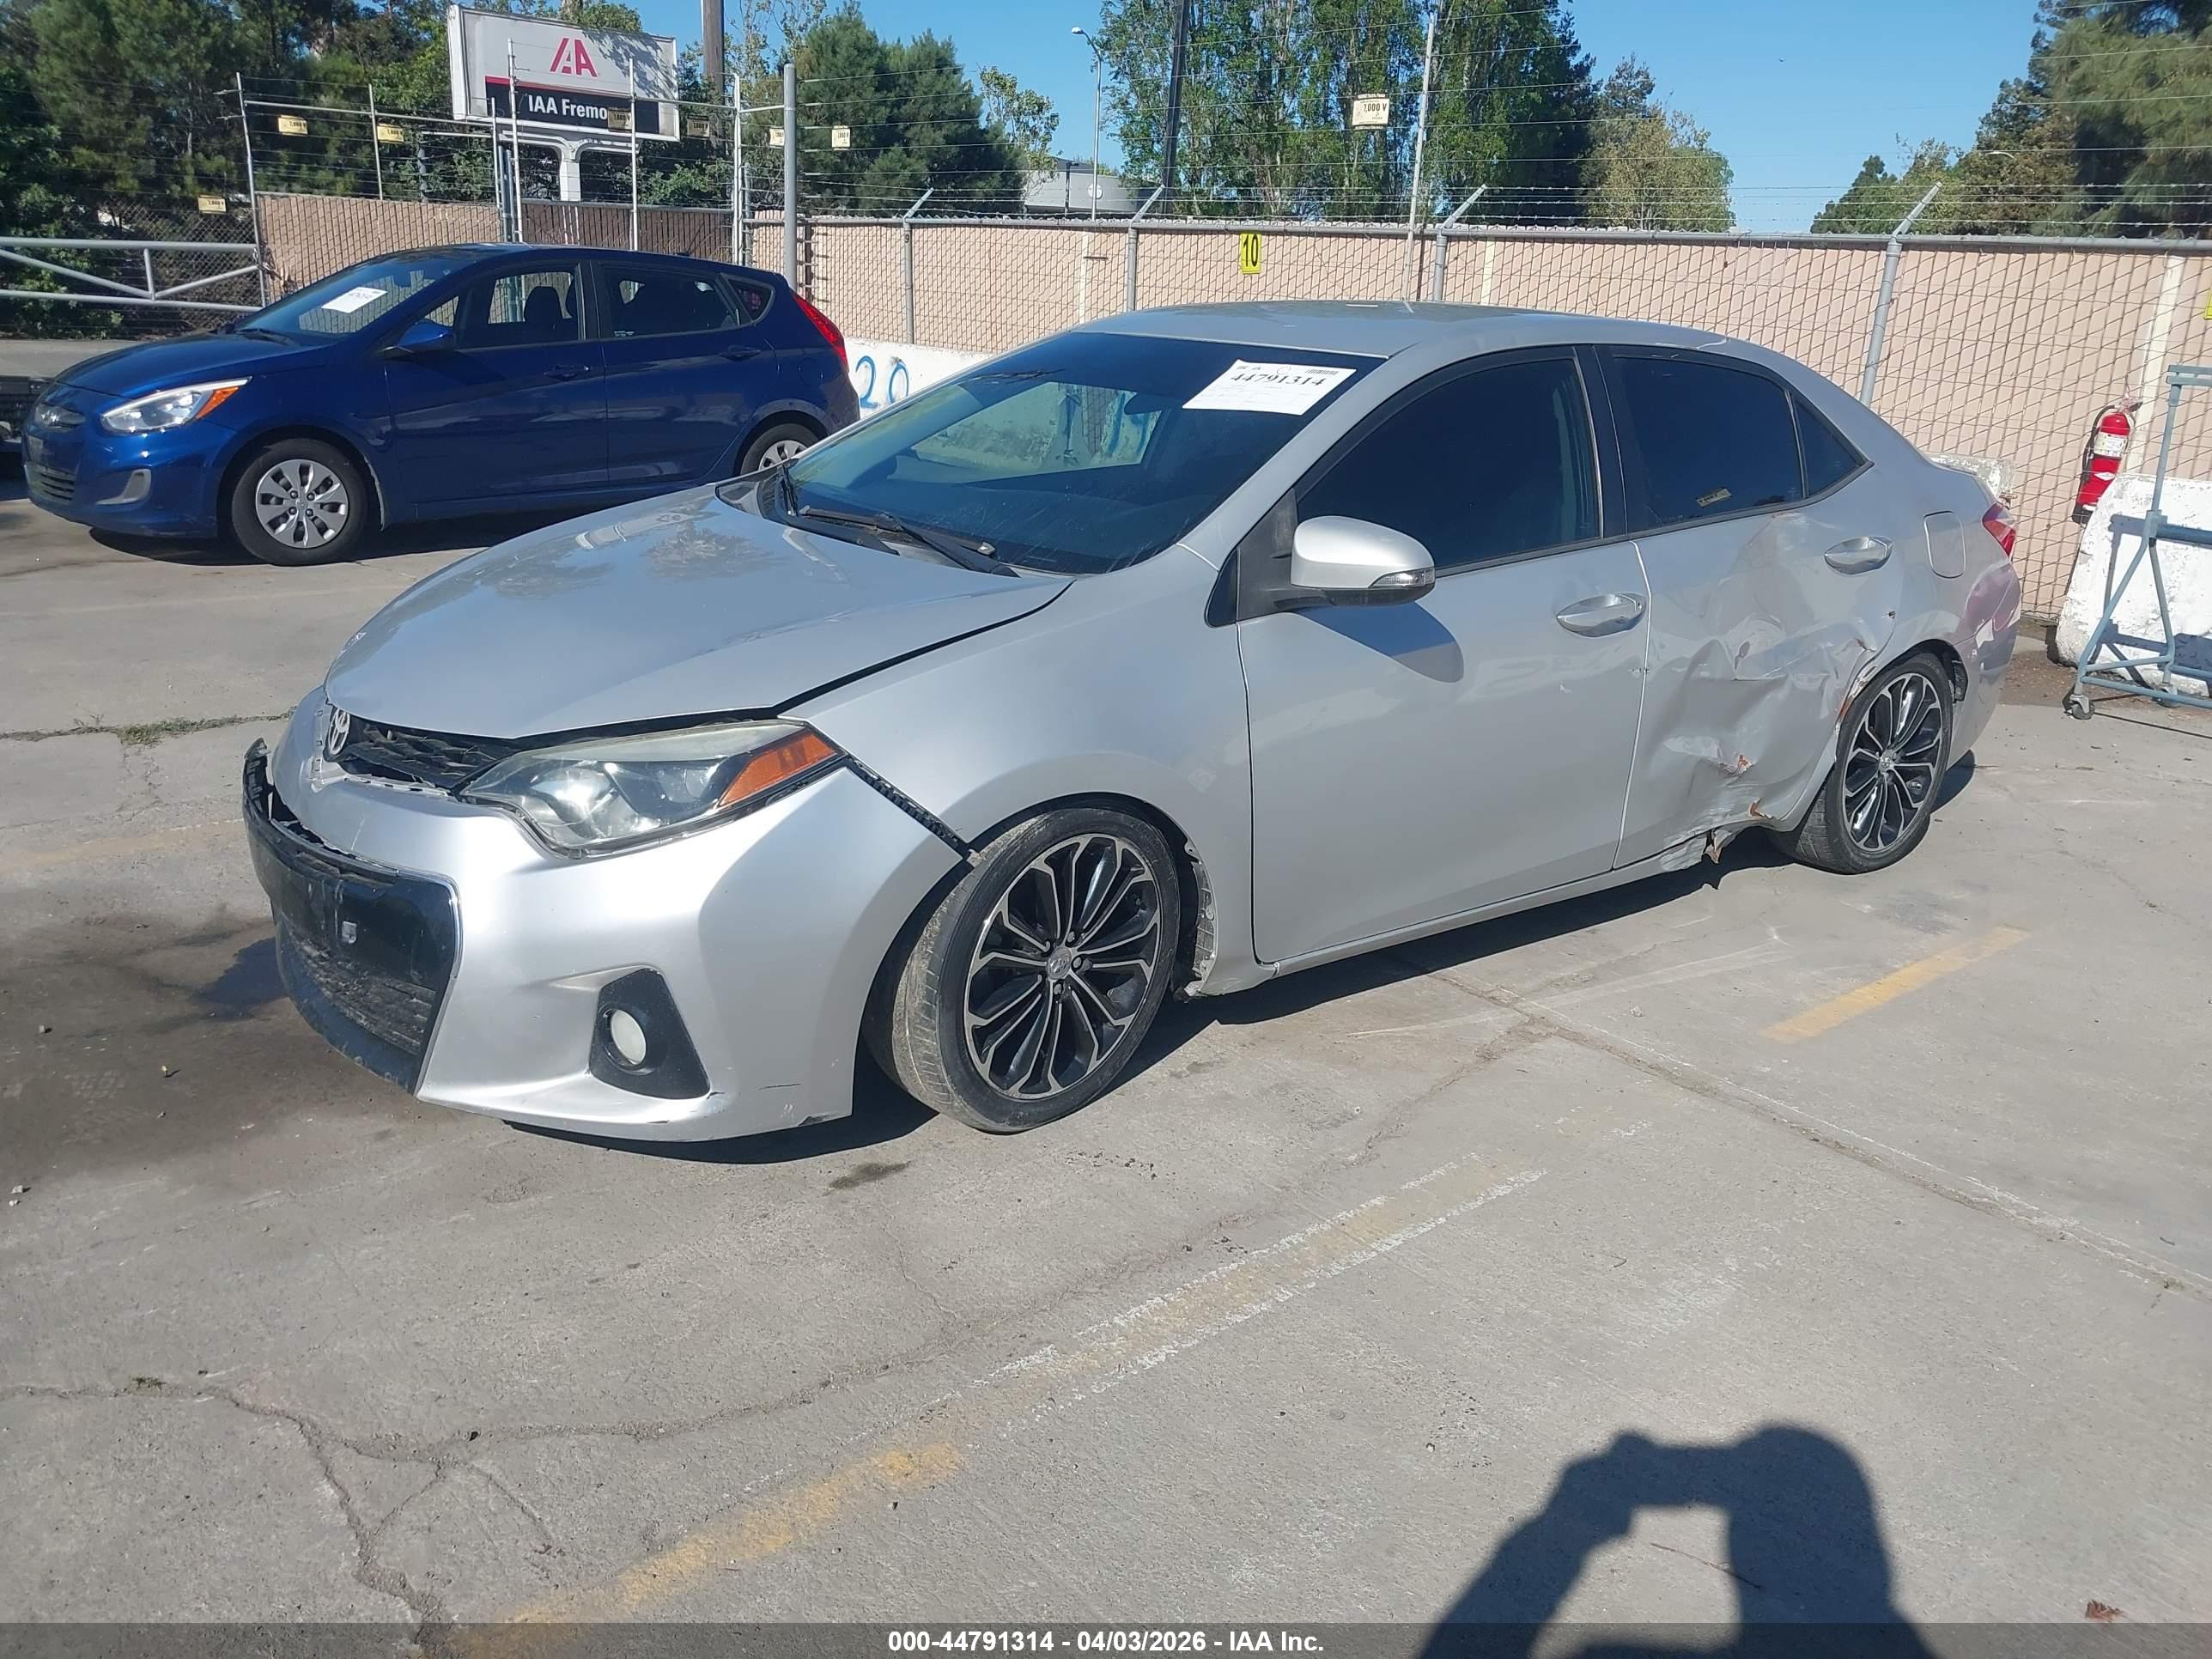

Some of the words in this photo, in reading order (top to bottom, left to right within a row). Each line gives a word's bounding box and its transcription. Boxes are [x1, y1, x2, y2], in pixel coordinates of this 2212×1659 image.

[528, 94, 557, 113] IAA
[562, 99, 608, 119] Fremo
[1364, 102, 1381, 112] 7,000
[1382, 102, 1388, 112] V
[1243, 234, 1259, 267] 10
[1231, 373, 1327, 386] 44791314
